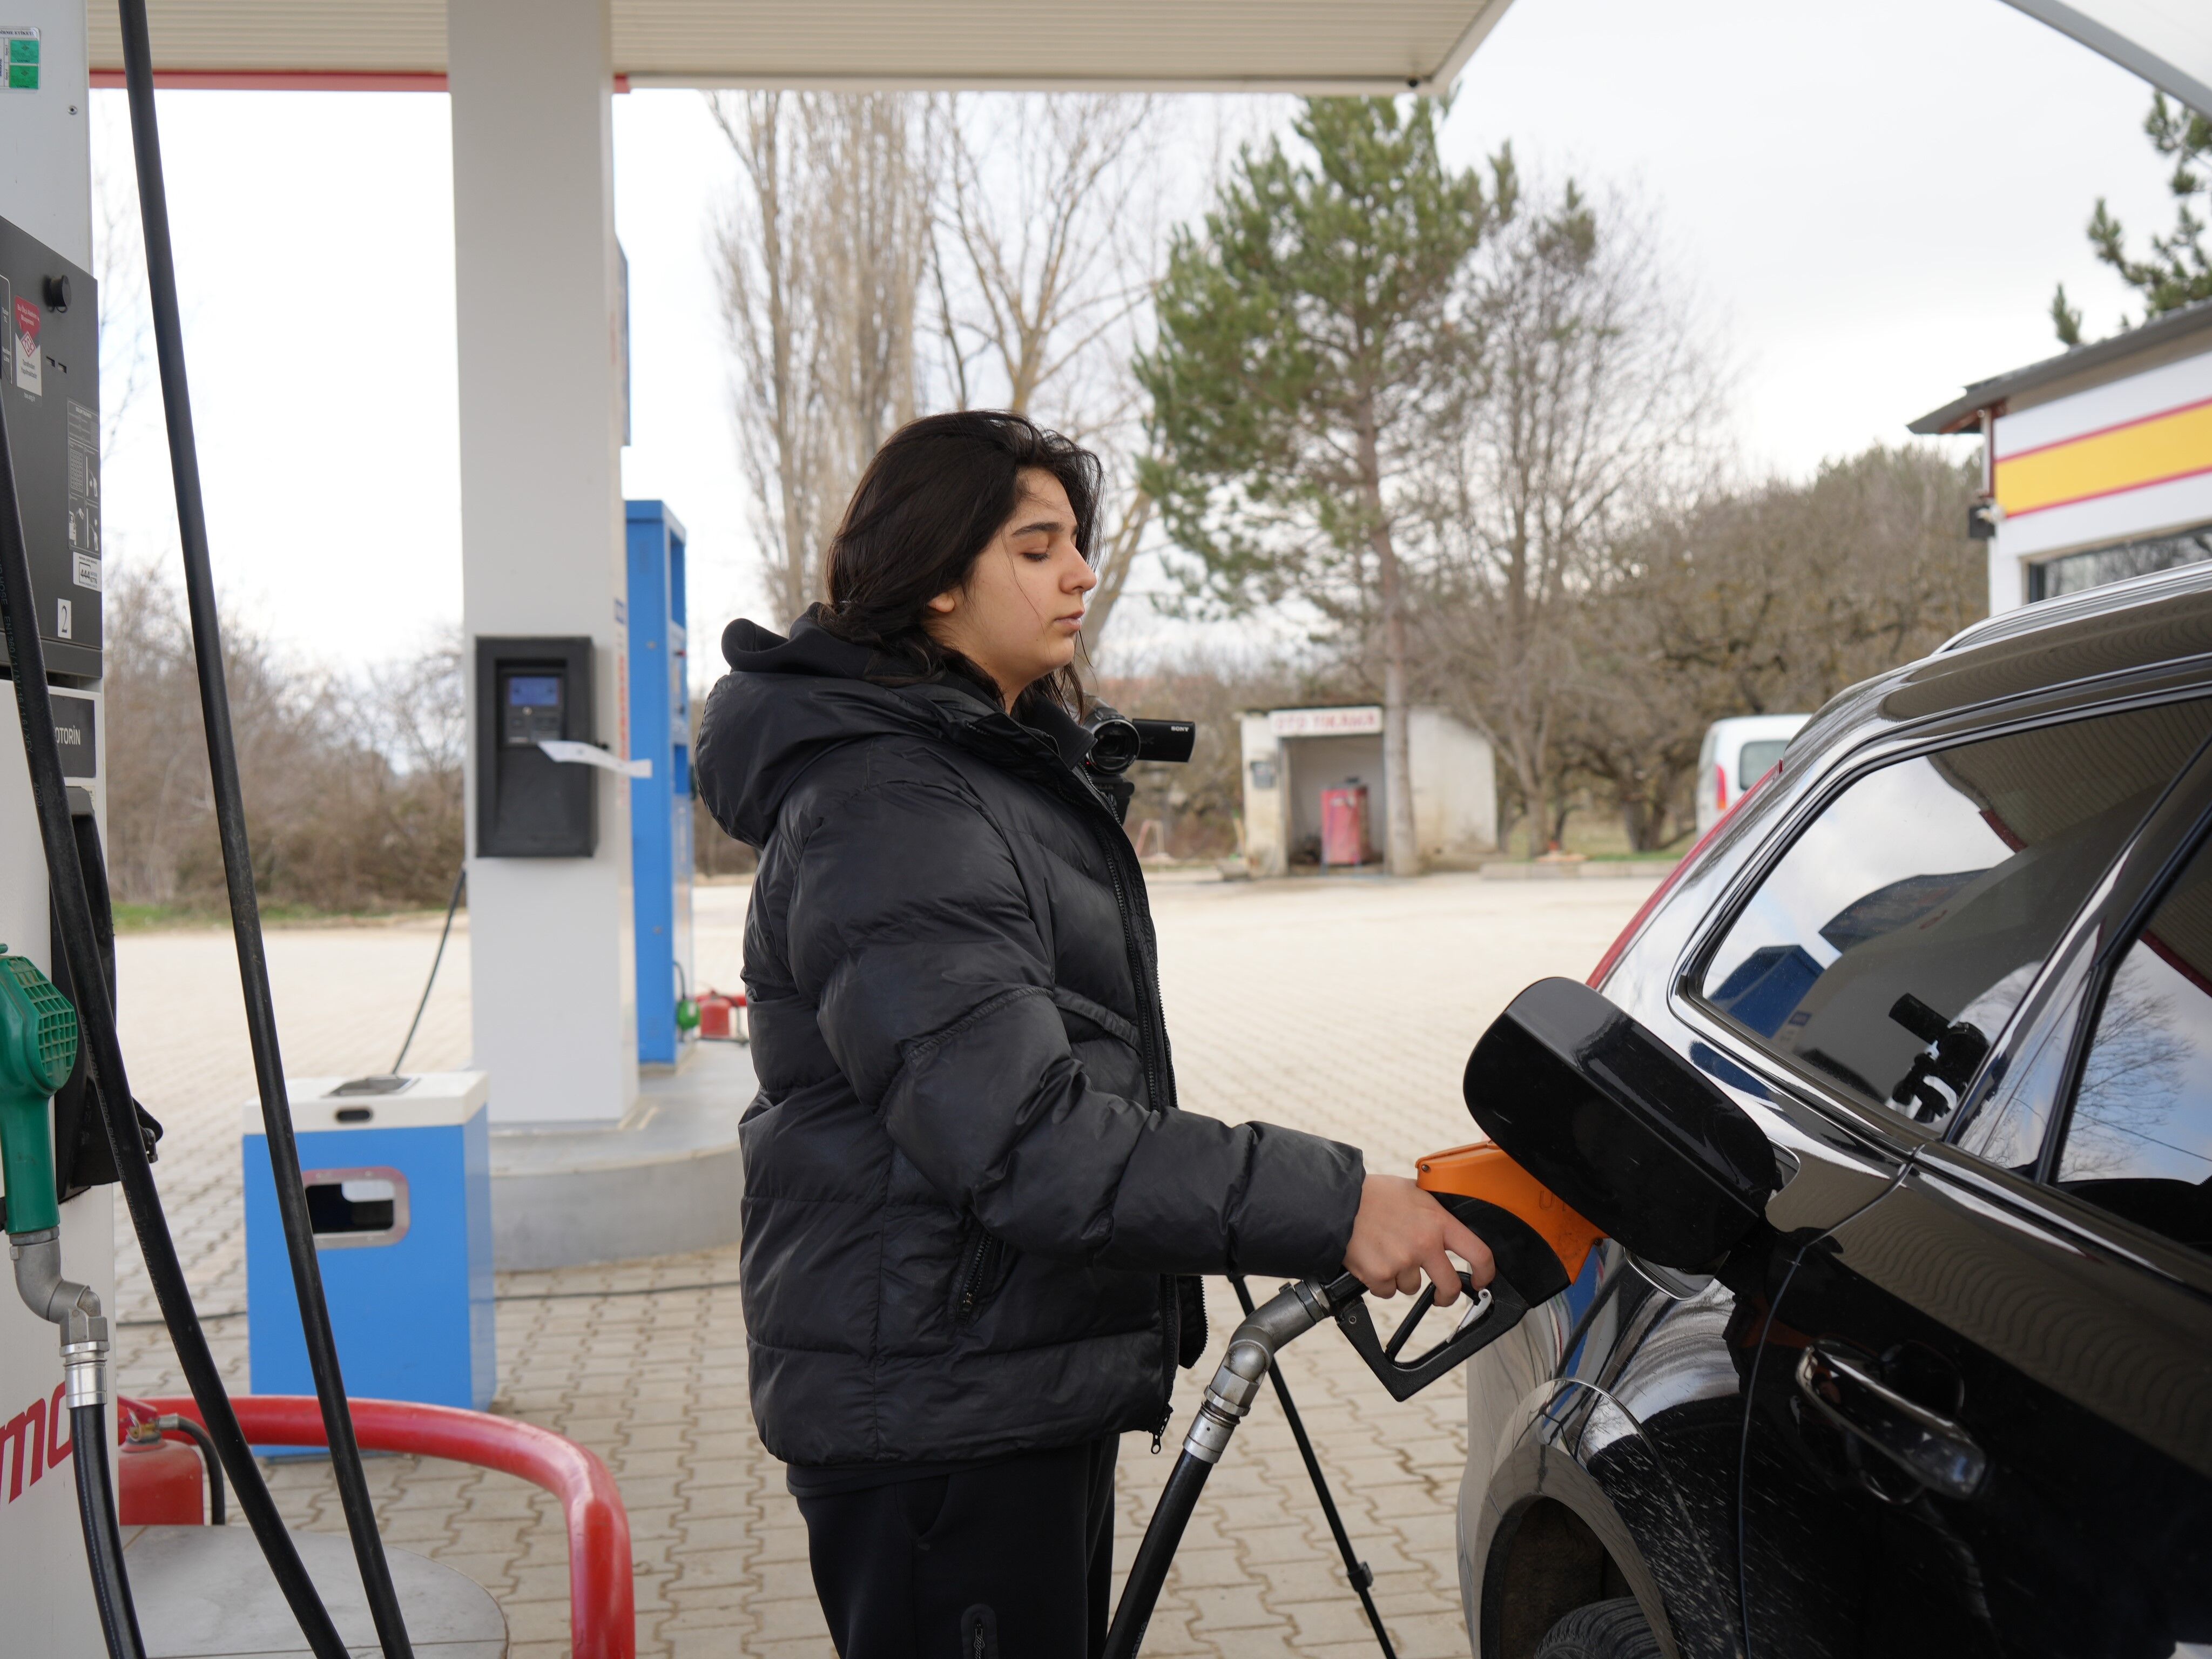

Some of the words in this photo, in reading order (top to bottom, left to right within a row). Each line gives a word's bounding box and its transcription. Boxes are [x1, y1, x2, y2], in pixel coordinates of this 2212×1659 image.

[80, 569, 90, 580] 444
[62, 605, 68, 633] 2
[55, 725, 80, 746] OTORİN
